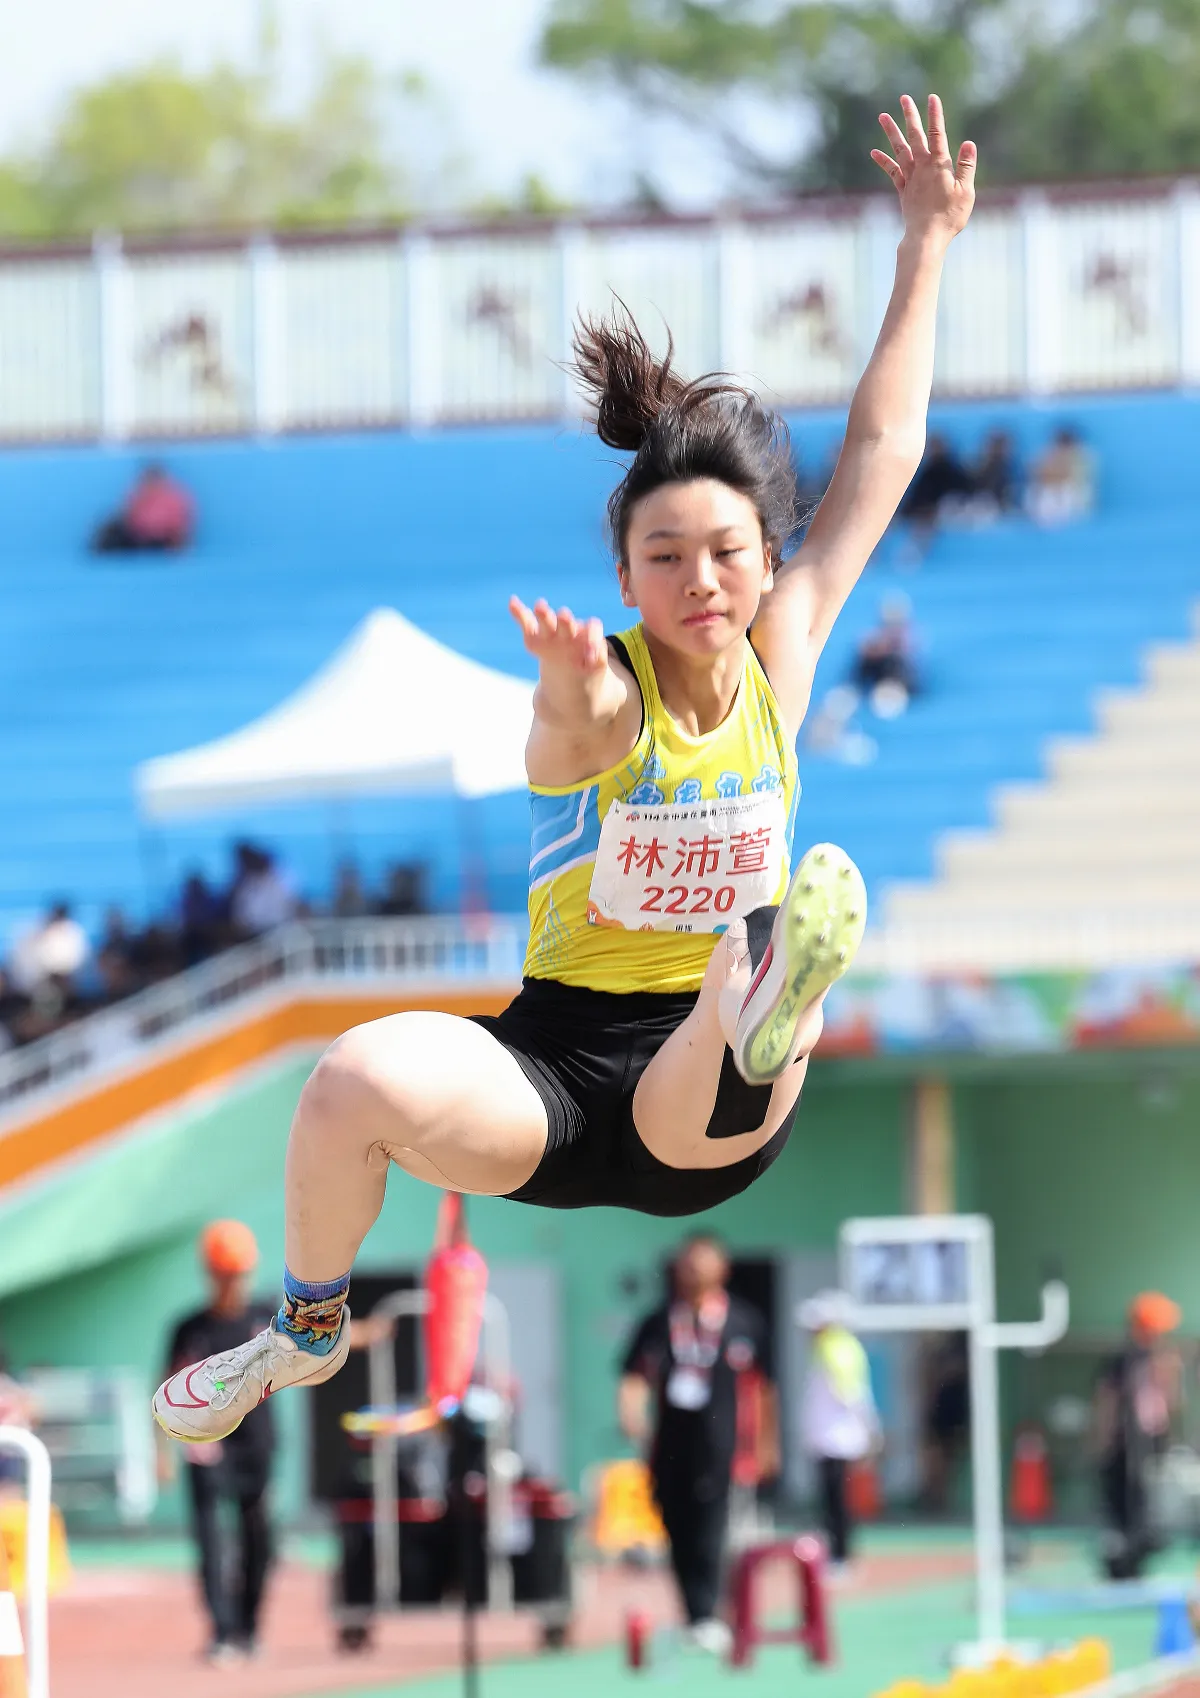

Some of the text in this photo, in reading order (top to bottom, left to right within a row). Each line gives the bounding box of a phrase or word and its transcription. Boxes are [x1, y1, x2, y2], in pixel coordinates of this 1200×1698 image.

[616, 827, 772, 878] 林沛萱
[639, 886, 736, 914] 2220
